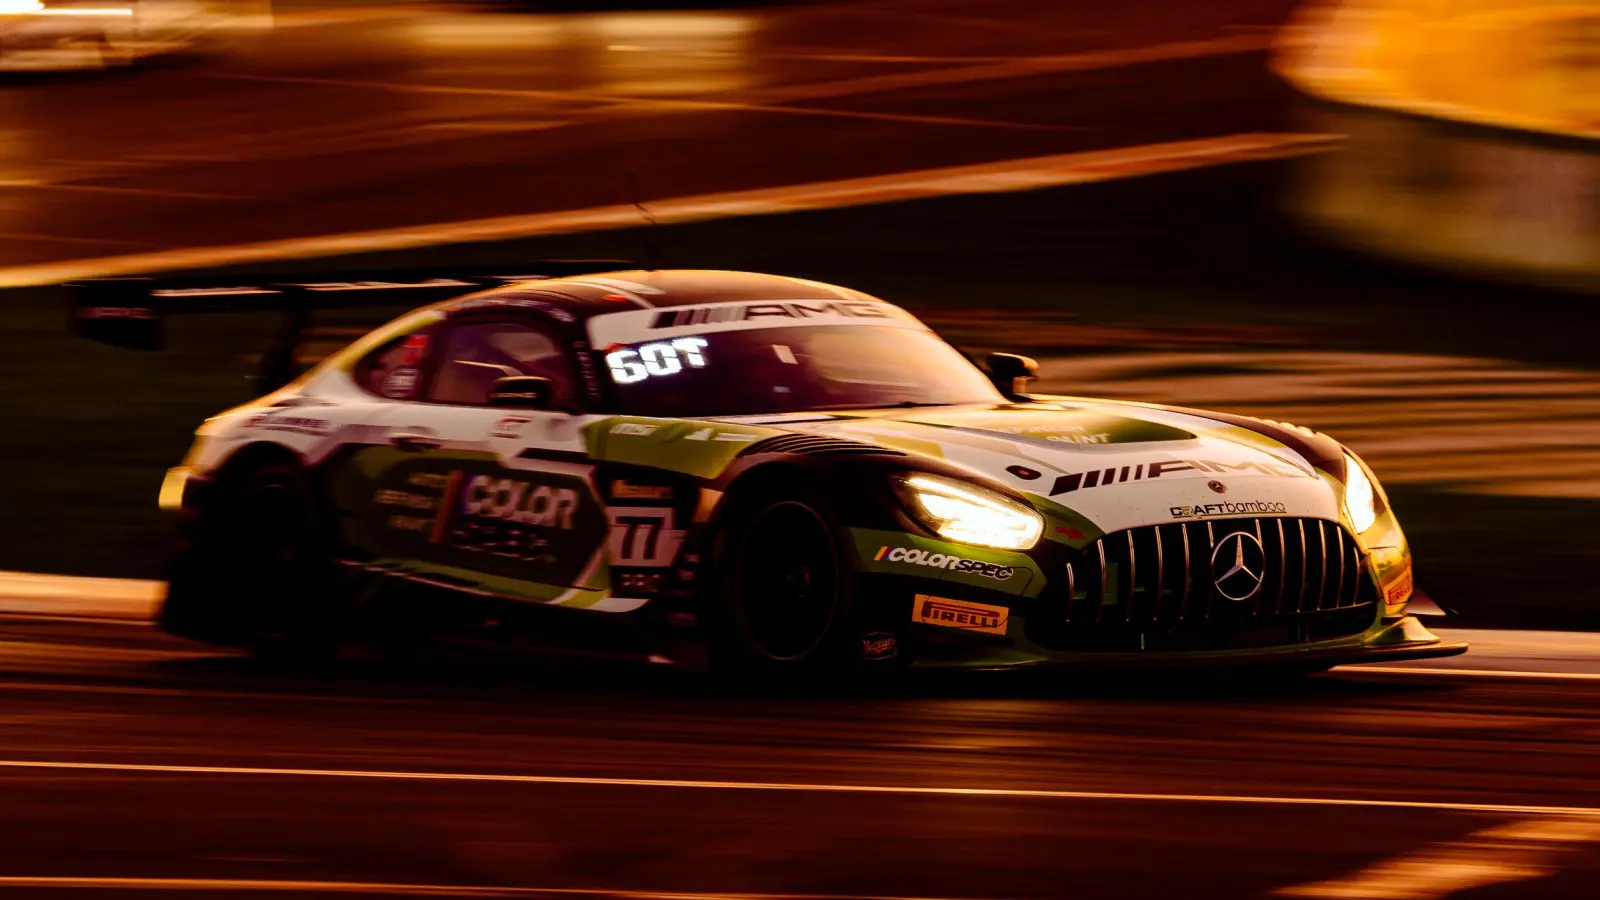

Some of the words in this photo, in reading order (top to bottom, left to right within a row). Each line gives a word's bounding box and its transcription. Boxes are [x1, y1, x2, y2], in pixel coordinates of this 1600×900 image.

[743, 302, 888, 320] AMG
[1147, 459, 1316, 479] AMG
[464, 472, 579, 531] COLOR
[615, 516, 665, 560] 77
[921, 600, 1001, 628] PIRELLI
